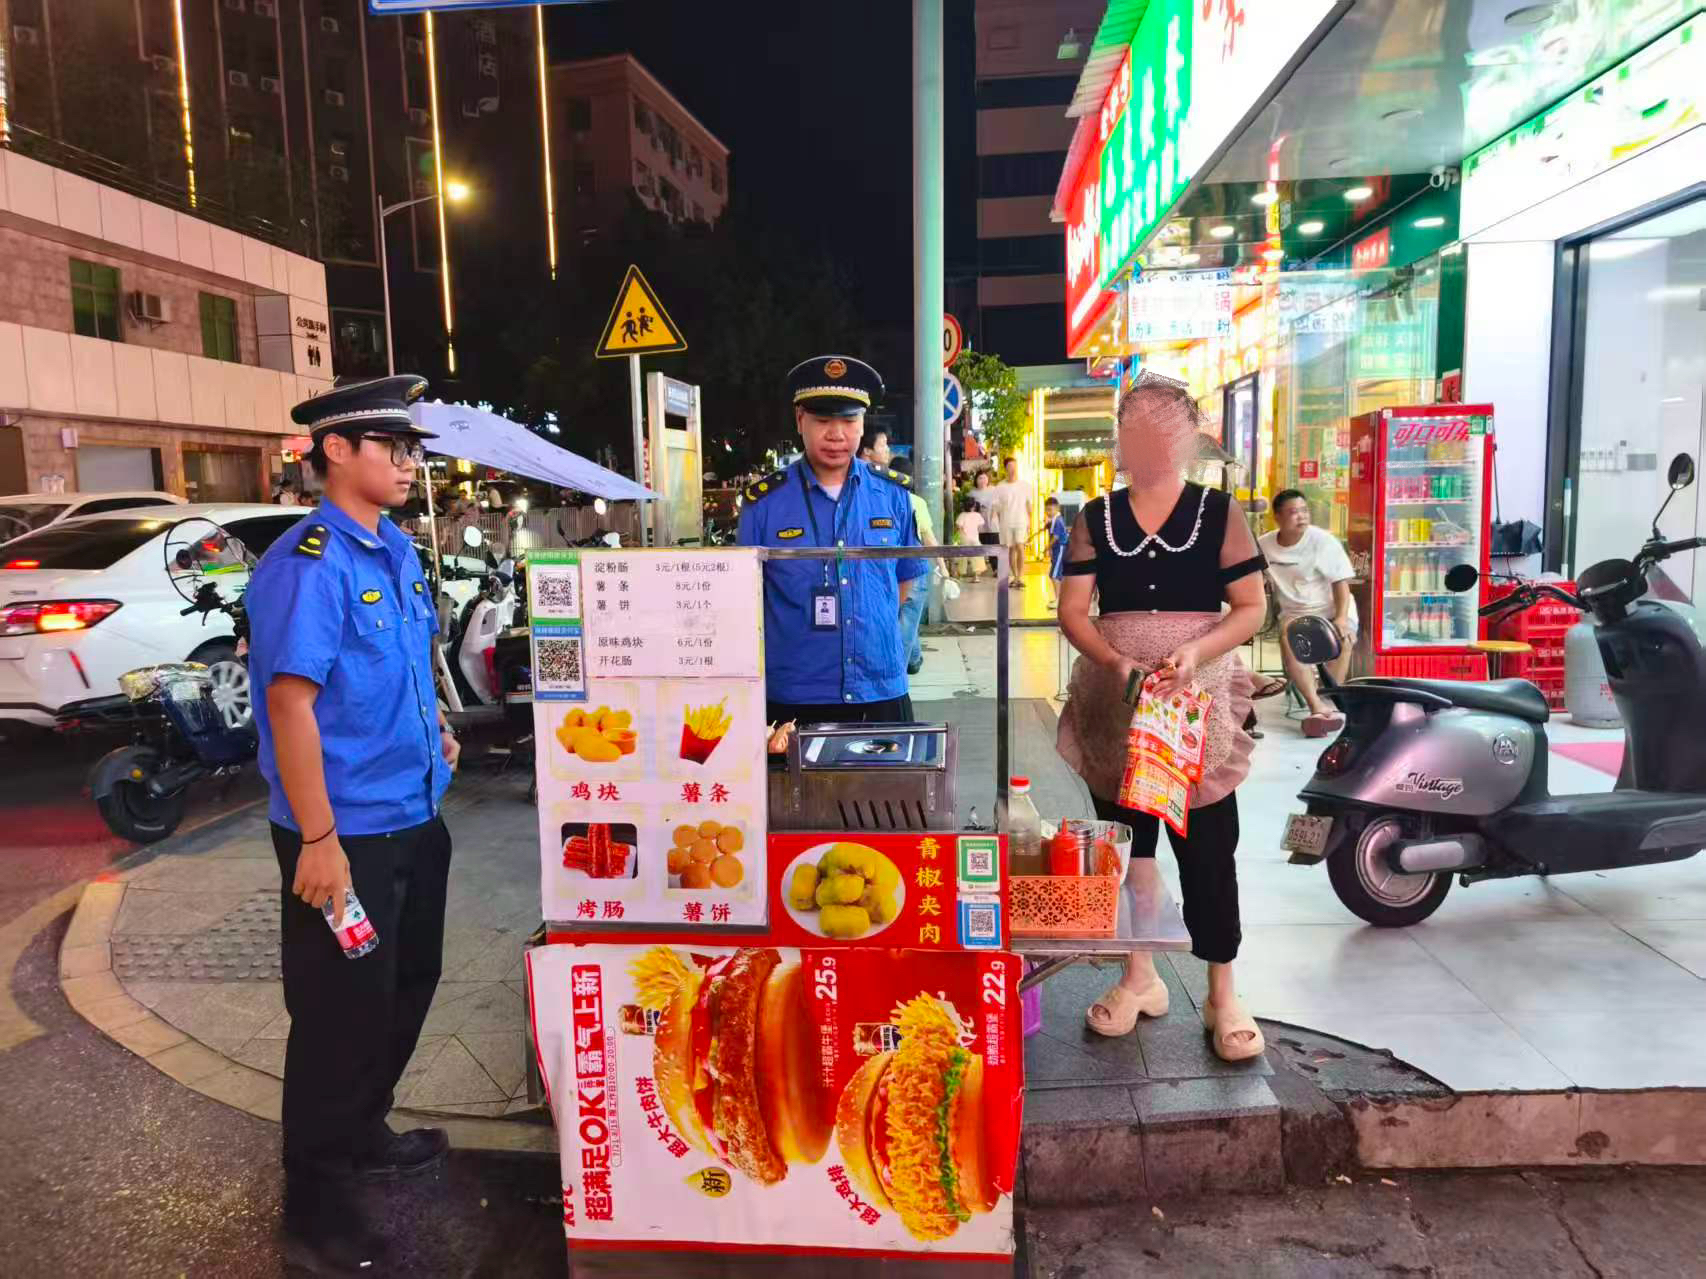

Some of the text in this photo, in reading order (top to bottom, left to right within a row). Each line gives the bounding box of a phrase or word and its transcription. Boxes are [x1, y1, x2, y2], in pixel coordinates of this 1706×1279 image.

[1392, 421, 1471, 449] 可口可乐
[594, 562, 629, 573] 淀粉肠
[596, 580, 630, 592] 薯条
[596, 599, 630, 611] 薯饼
[598, 637, 644, 648] 原味鸡块
[599, 656, 633, 667] 开花肠
[571, 781, 622, 801] 鸡块
[681, 782, 732, 803] 薯条
[914, 836, 944, 945] 青椒夹肉
[577, 899, 625, 919] 烤肠
[682, 901, 732, 922] 薯饼
[573, 971, 603, 1074] 霸气上新
[635, 1076, 690, 1159] 超大牛肉饼
[700, 1169, 727, 1193] 新
[827, 1165, 882, 1225] 超大鸡排
